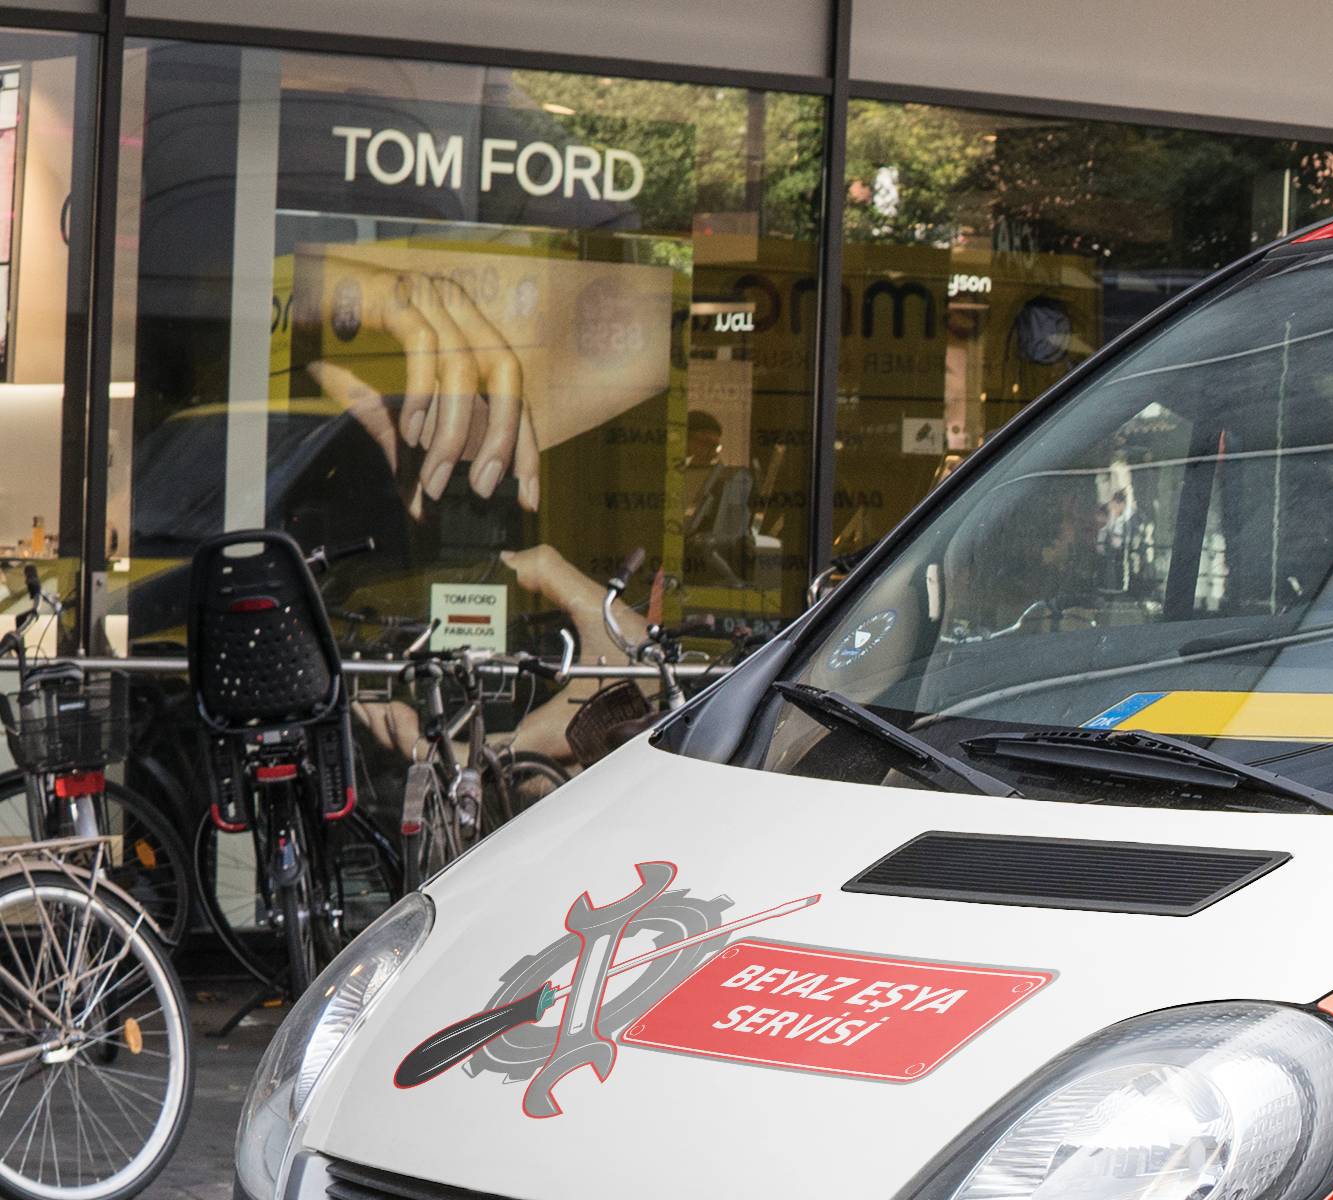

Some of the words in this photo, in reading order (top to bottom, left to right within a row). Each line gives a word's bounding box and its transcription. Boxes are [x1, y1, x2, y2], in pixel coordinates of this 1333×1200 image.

[332, 126, 463, 190] TOM
[481, 138, 645, 202] FORD
[947, 273, 992, 297] yson
[444, 593, 466, 605] TOM
[468, 593, 496, 606] FORD
[443, 626, 495, 637] FABULOUS
[1087, 716, 1121, 727] DK
[720, 964, 861, 1001] BEYAZ
[844, 981, 968, 1013] EŞYA
[711, 1005, 890, 1046] SERVİSİ
